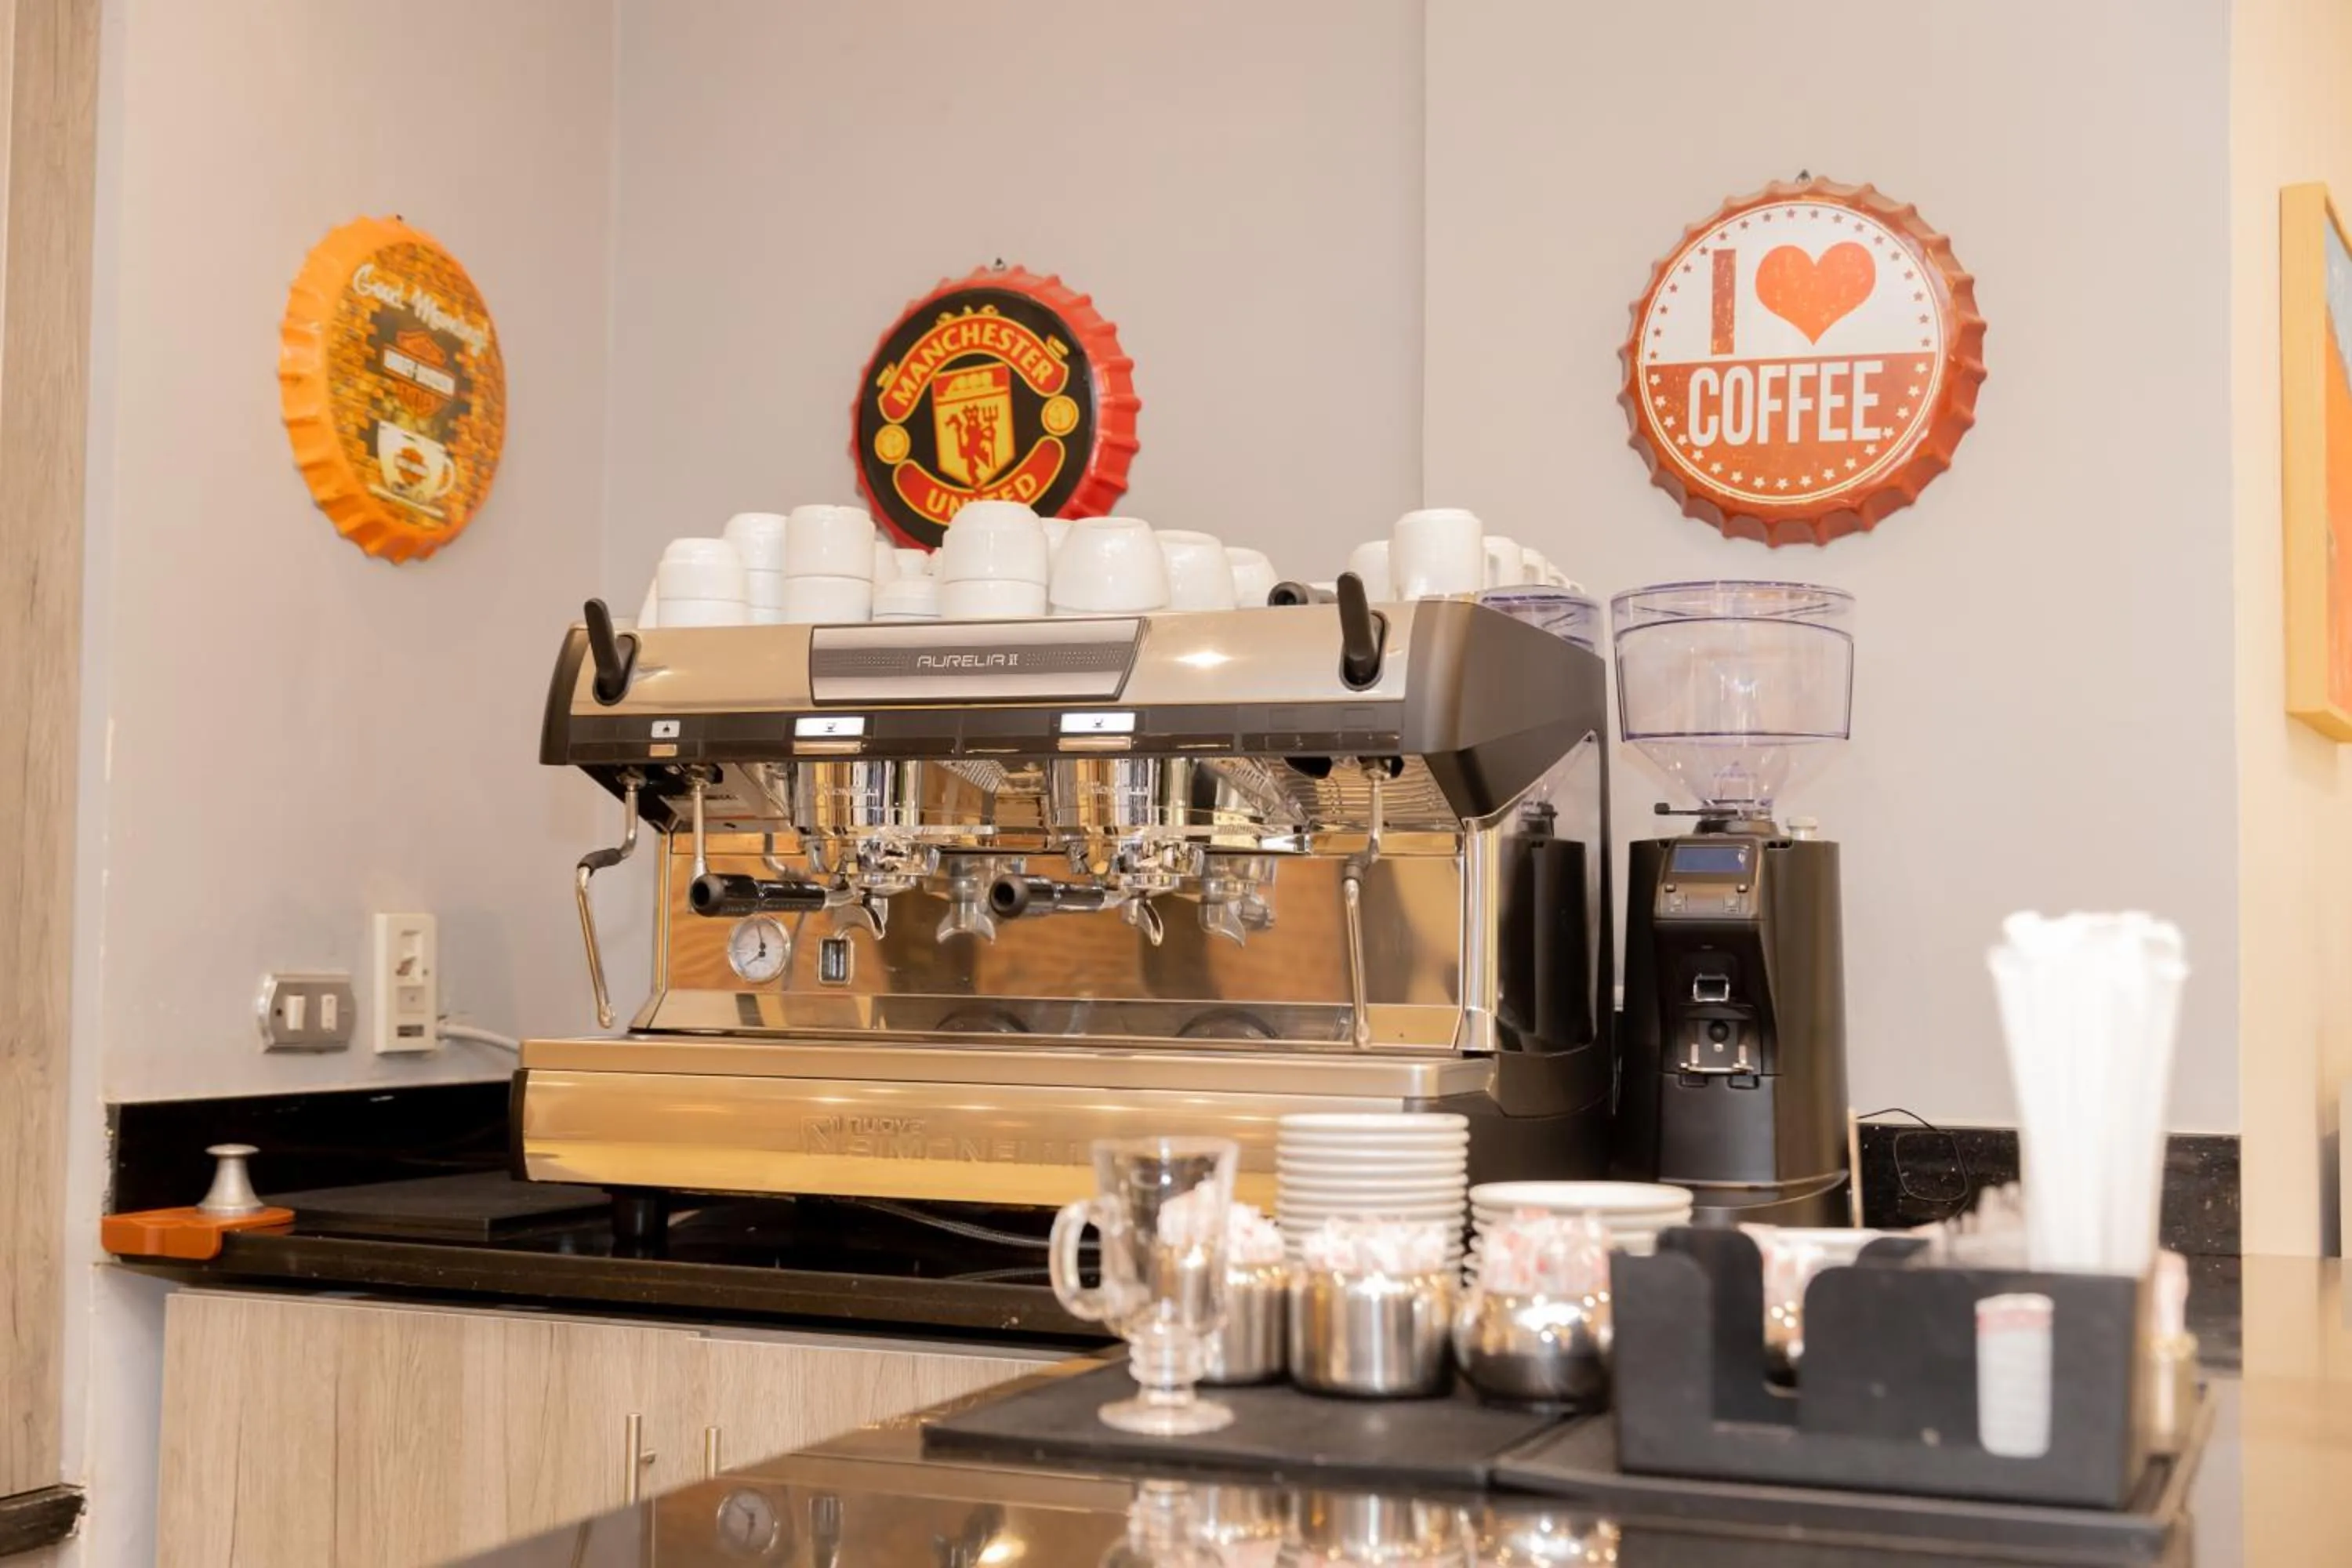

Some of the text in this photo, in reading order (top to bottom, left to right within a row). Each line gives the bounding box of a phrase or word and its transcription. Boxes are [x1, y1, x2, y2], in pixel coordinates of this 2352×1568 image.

[1711, 249, 1736, 356] I
[893, 323, 1054, 406] MANCHESTER
[1688, 361, 1883, 447] COFFEE
[927, 473, 1037, 517] UNED
[916, 653, 1006, 668] AURELIA
